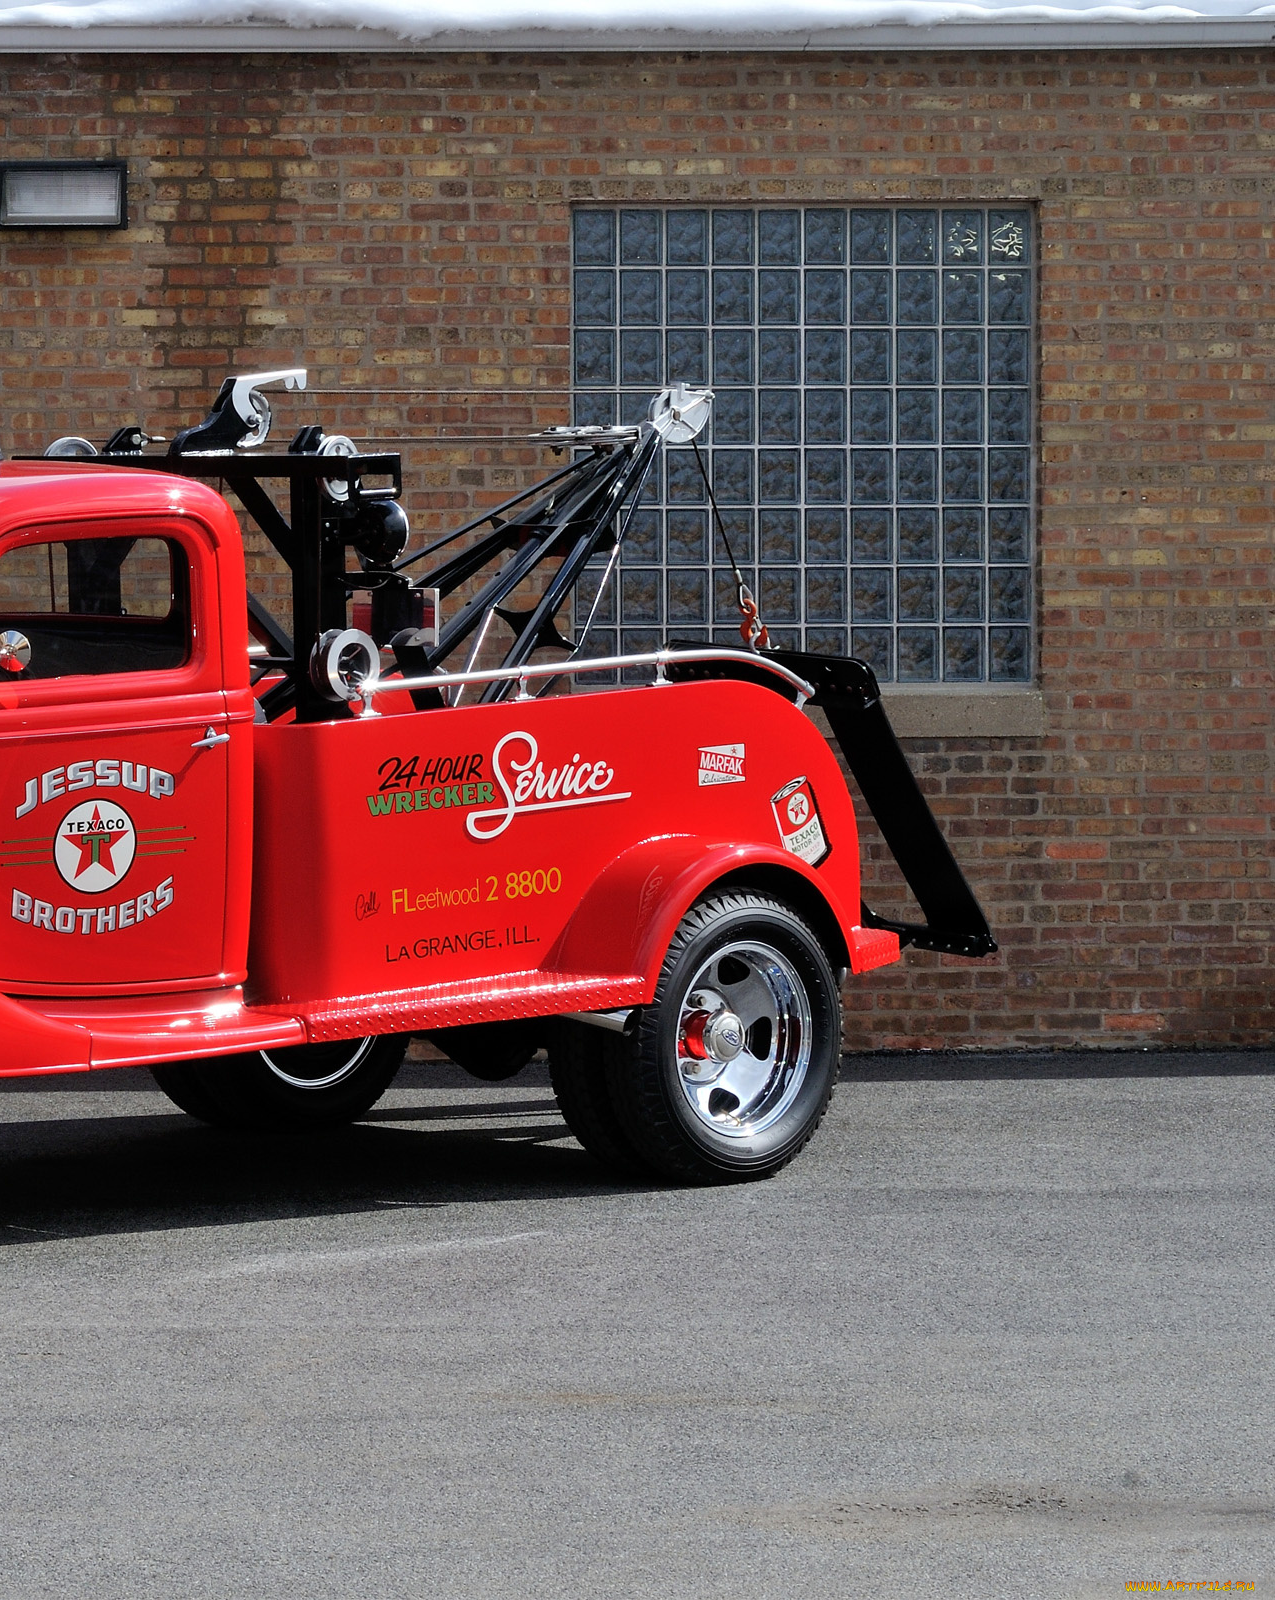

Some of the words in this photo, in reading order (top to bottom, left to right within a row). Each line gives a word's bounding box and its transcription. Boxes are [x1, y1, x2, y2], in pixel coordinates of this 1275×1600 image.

[377, 755, 420, 791] 24
[421, 754, 484, 785] HOUR
[700, 752, 744, 775] MARFAK
[15, 759, 175, 820] JESSUP
[366, 781, 496, 817] WRECKER
[466, 730, 632, 840] Service
[66, 817, 125, 833] TEXACO
[789, 821, 819, 846] TEXACO
[791, 838, 813, 853] MOTOR
[11, 875, 174, 935] BROTHERS
[391, 878, 480, 914] FLeetwood
[485, 875, 499, 902] 2
[505, 867, 562, 900] 8800
[413, 929, 502, 959] GRANGE,
[506, 925, 540, 946] ILL.
